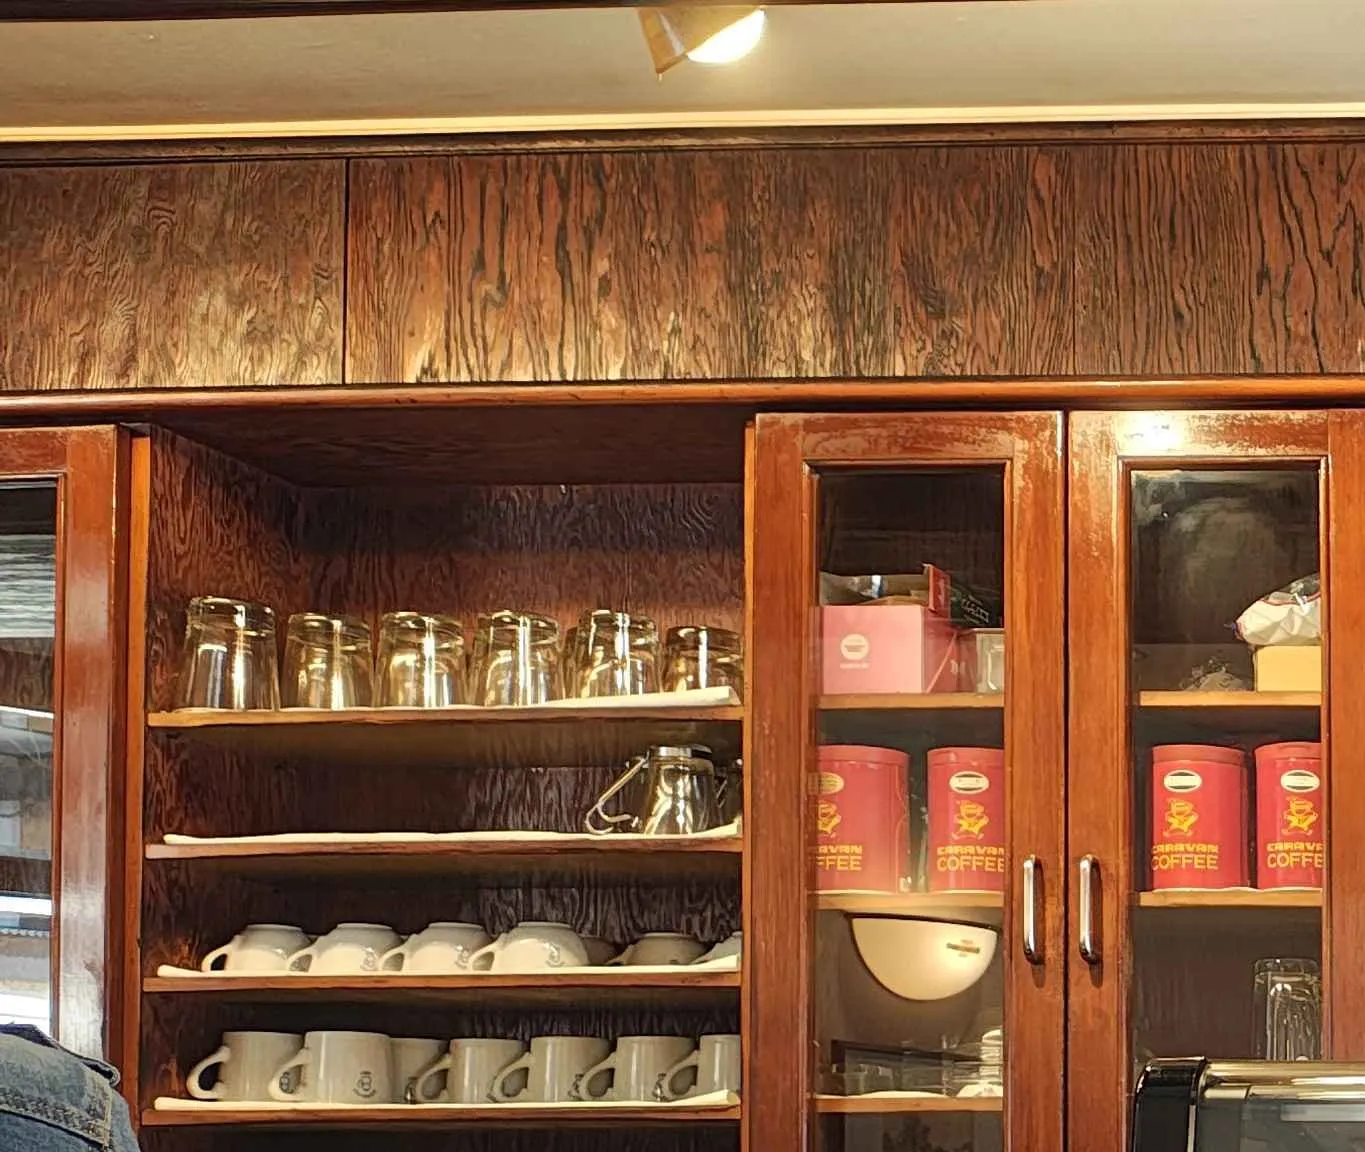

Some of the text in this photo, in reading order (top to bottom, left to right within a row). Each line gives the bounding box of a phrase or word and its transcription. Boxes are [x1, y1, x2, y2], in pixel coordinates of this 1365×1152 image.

[1152, 842, 1219, 855] CARAVAN
[1151, 853, 1219, 872] COFFEE
[1267, 852, 1324, 869] COFFE
